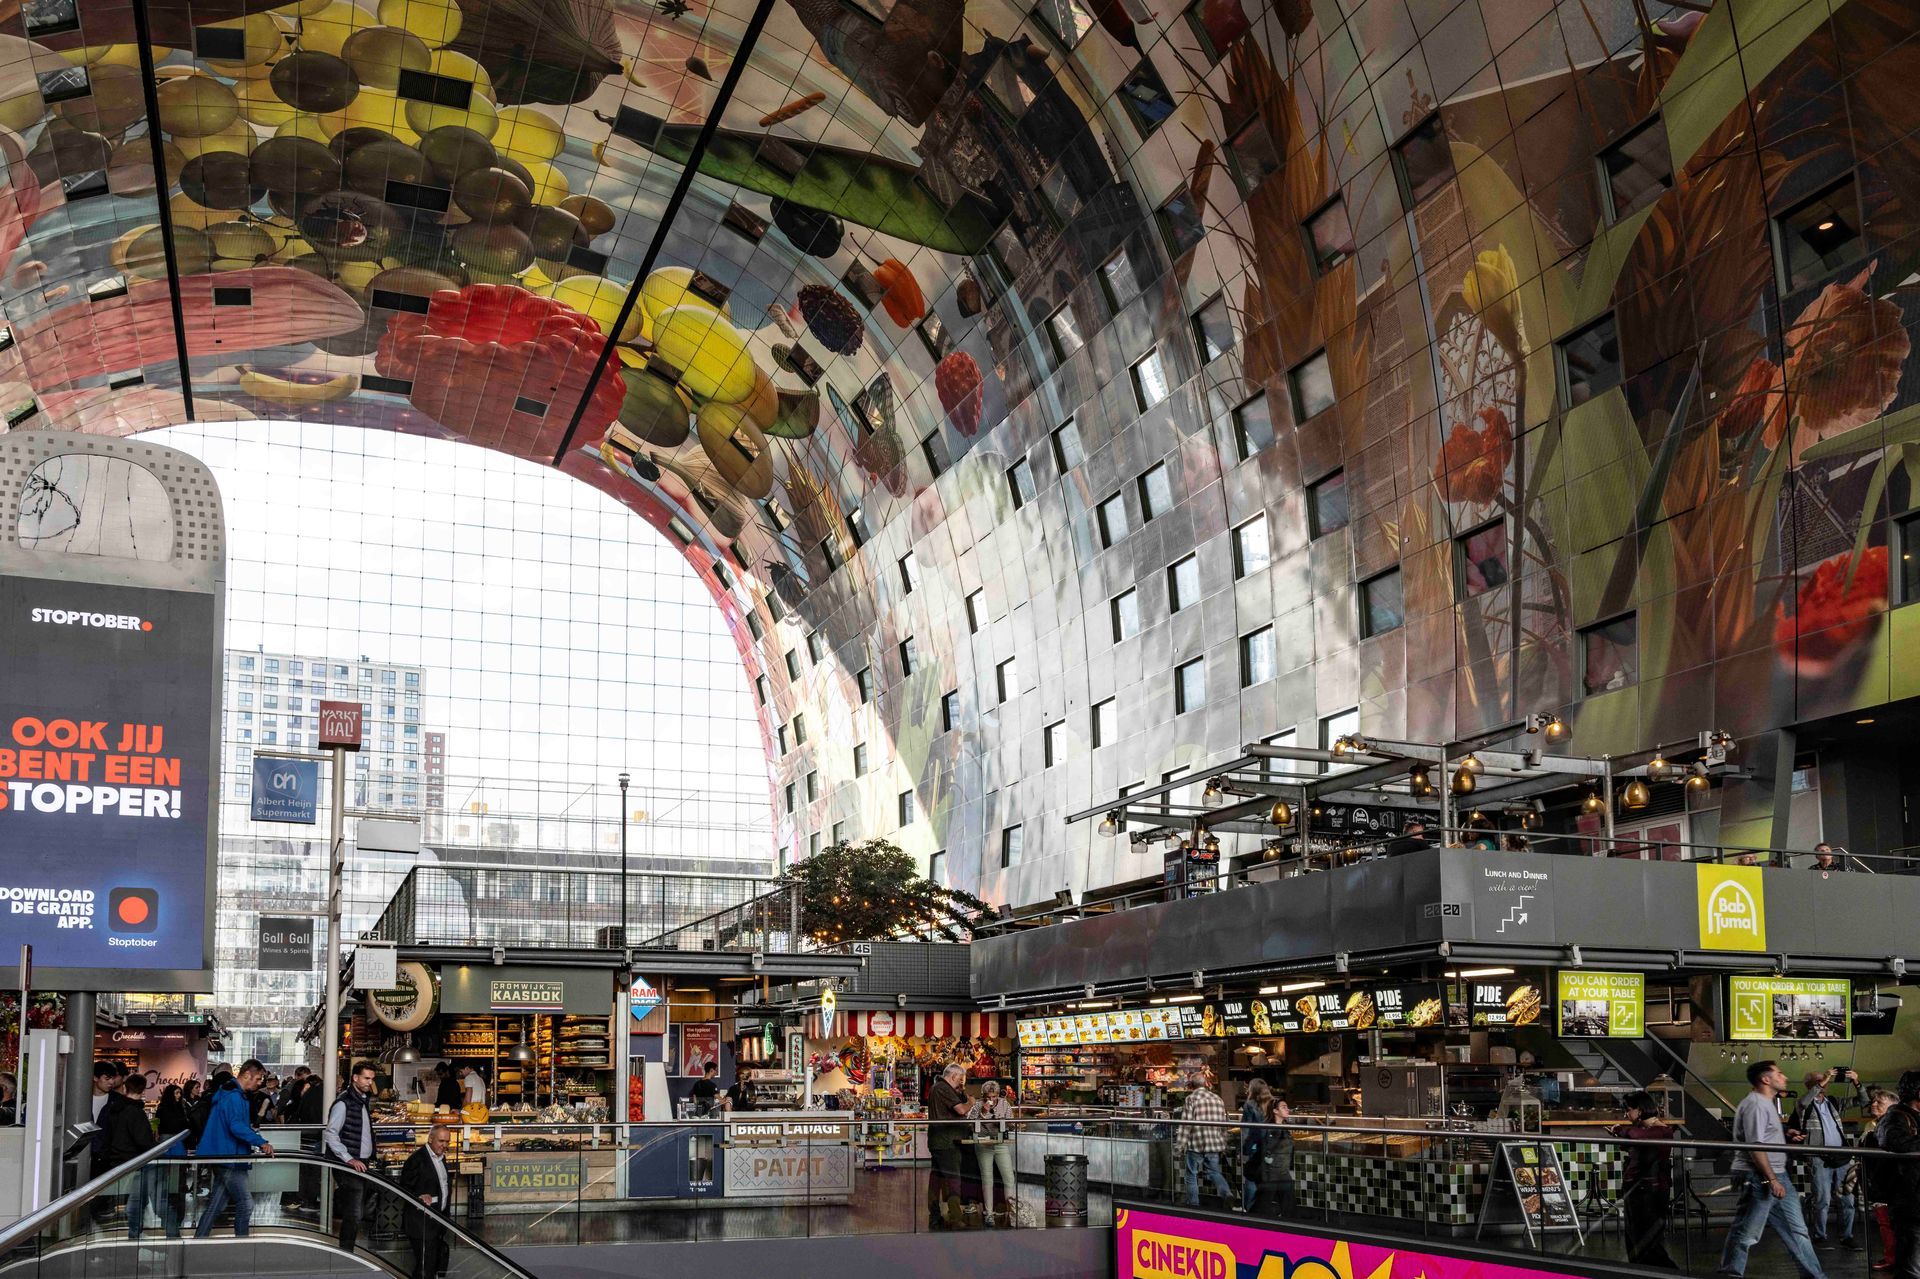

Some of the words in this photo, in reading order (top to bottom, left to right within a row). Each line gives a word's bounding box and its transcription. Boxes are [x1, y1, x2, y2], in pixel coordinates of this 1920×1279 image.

[322, 709, 359, 720] MARKT
[325, 721, 354, 737] HAL
[12, 717, 109, 750] OOK
[117, 723, 163, 754] JIJ
[0, 748, 96, 782] BENT
[104, 754, 181, 786] EEN
[256, 798, 286, 806] Albert
[288, 800, 312, 809] Heijn
[256, 808, 310, 818] Supermarkt
[1488, 880, 1508, 892] with
[0, 887, 95, 902] DOWNLOAD
[11, 902, 34, 914] DE
[37, 903, 94, 916] GRATIS
[1718, 892, 1746, 914] Bab
[56, 916, 94, 930] APP.
[1714, 912, 1751, 935] Tuma
[108, 937, 158, 948] Stoptober
[262, 932, 284, 944] Gall
[289, 932, 310, 944] Gall
[360, 932, 379, 941] 48
[360, 952, 375, 962] DE
[360, 962, 385, 971] TIJD
[360, 970, 389, 980] TRAP
[1564, 976, 1584, 985] YOU
[1586, 976, 1608, 986] CAN
[1610, 976, 1640, 986] ORDER
[1734, 980, 1751, 990] YOU
[1752, 981, 1769, 991] CAN
[1771, 982, 1794, 992] ORDER
[1796, 982, 1804, 992] AT
[1807, 983, 1826, 992] YOUR
[1828, 984, 1846, 992] TABLE
[494, 990, 560, 1001] KAASDOK
[632, 988, 657, 998] RAM
[1376, 990, 1402, 1006] PIDE
[1476, 986, 1502, 1002] PIDE
[1568, 988, 1579, 997] AT
[1582, 988, 1608, 998] YOUR
[1612, 988, 1636, 998] TABLE
[1224, 1002, 1243, 1014] WRAP
[1270, 998, 1289, 1012] WRAP
[1318, 994, 1340, 1011] PIDE
[738, 1125, 779, 1135] BRAM
[496, 1164, 561, 1174] CROMWIJK
[754, 1158, 824, 1178] PATAT
[496, 1173, 580, 1188] KAASDOK
[1136, 1238, 1226, 1279] CINEKID
